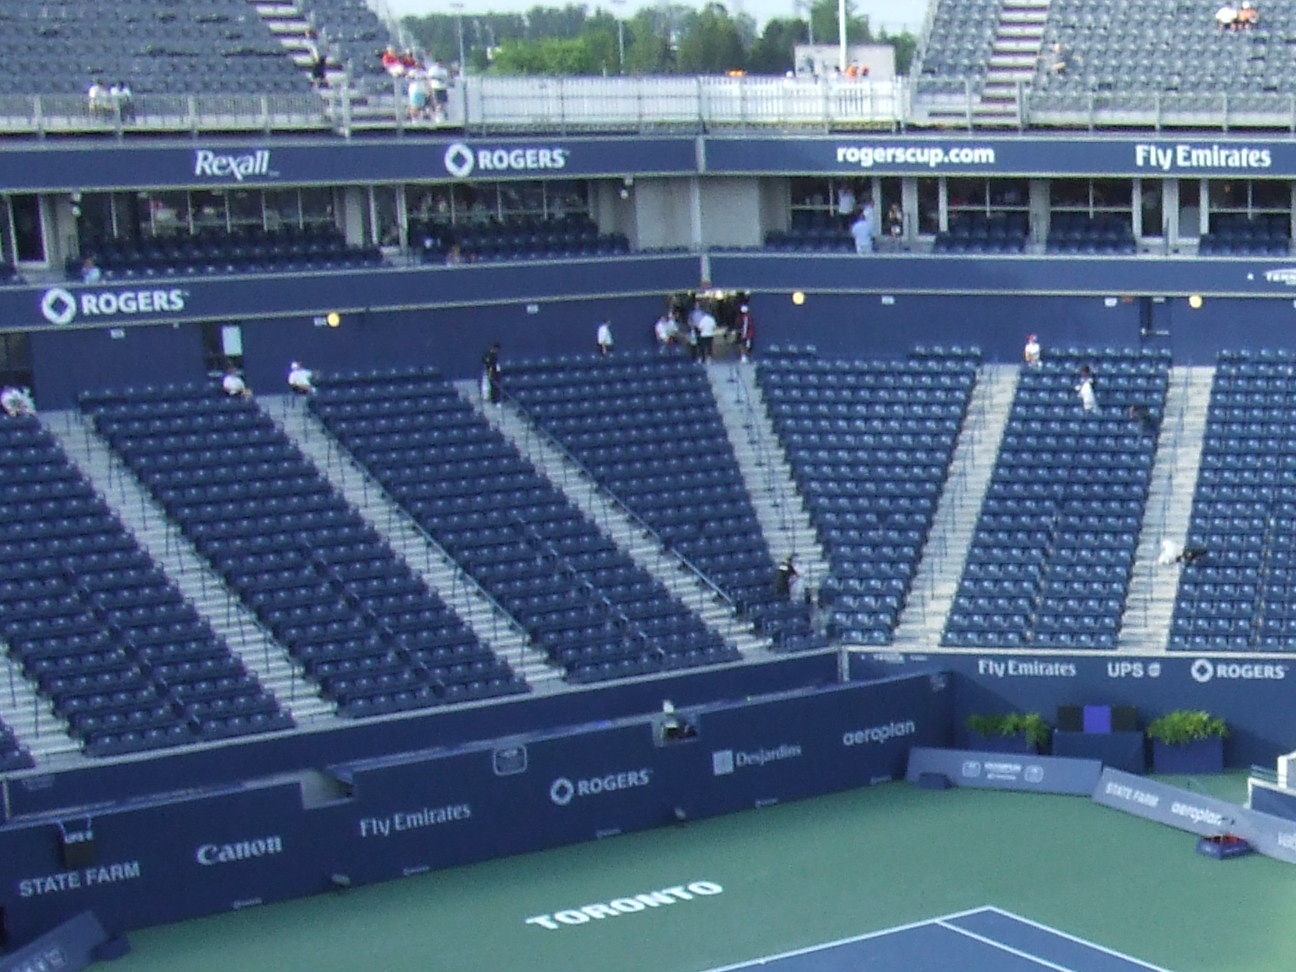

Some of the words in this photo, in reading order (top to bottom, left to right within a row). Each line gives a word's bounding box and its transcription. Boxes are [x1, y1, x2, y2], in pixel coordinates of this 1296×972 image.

[194, 149, 270, 181] Rexall
[477, 148, 566, 170] ROGERS
[836, 146, 995, 168] rogerscup.com
[1135, 144, 1173, 171] Fly
[1175, 144, 1272, 168] Emirates
[81, 289, 184, 315] ROGERS
[978, 658, 1005, 678] Fly
[1007, 659, 1077, 678] Emirates
[1107, 661, 1144, 678] UPS
[1216, 664, 1286, 680] ROGERS
[842, 719, 916, 747] aeroplan
[735, 743, 802, 769] Desjardins
[577, 768, 650, 797] ROGERS
[359, 817, 390, 838] Fly
[394, 803, 472, 832] Emirates
[196, 835, 283, 866] Canon
[19, 870, 82, 898] STATE
[86, 860, 141, 886] FARM
[524, 879, 723, 931] TORONTO
